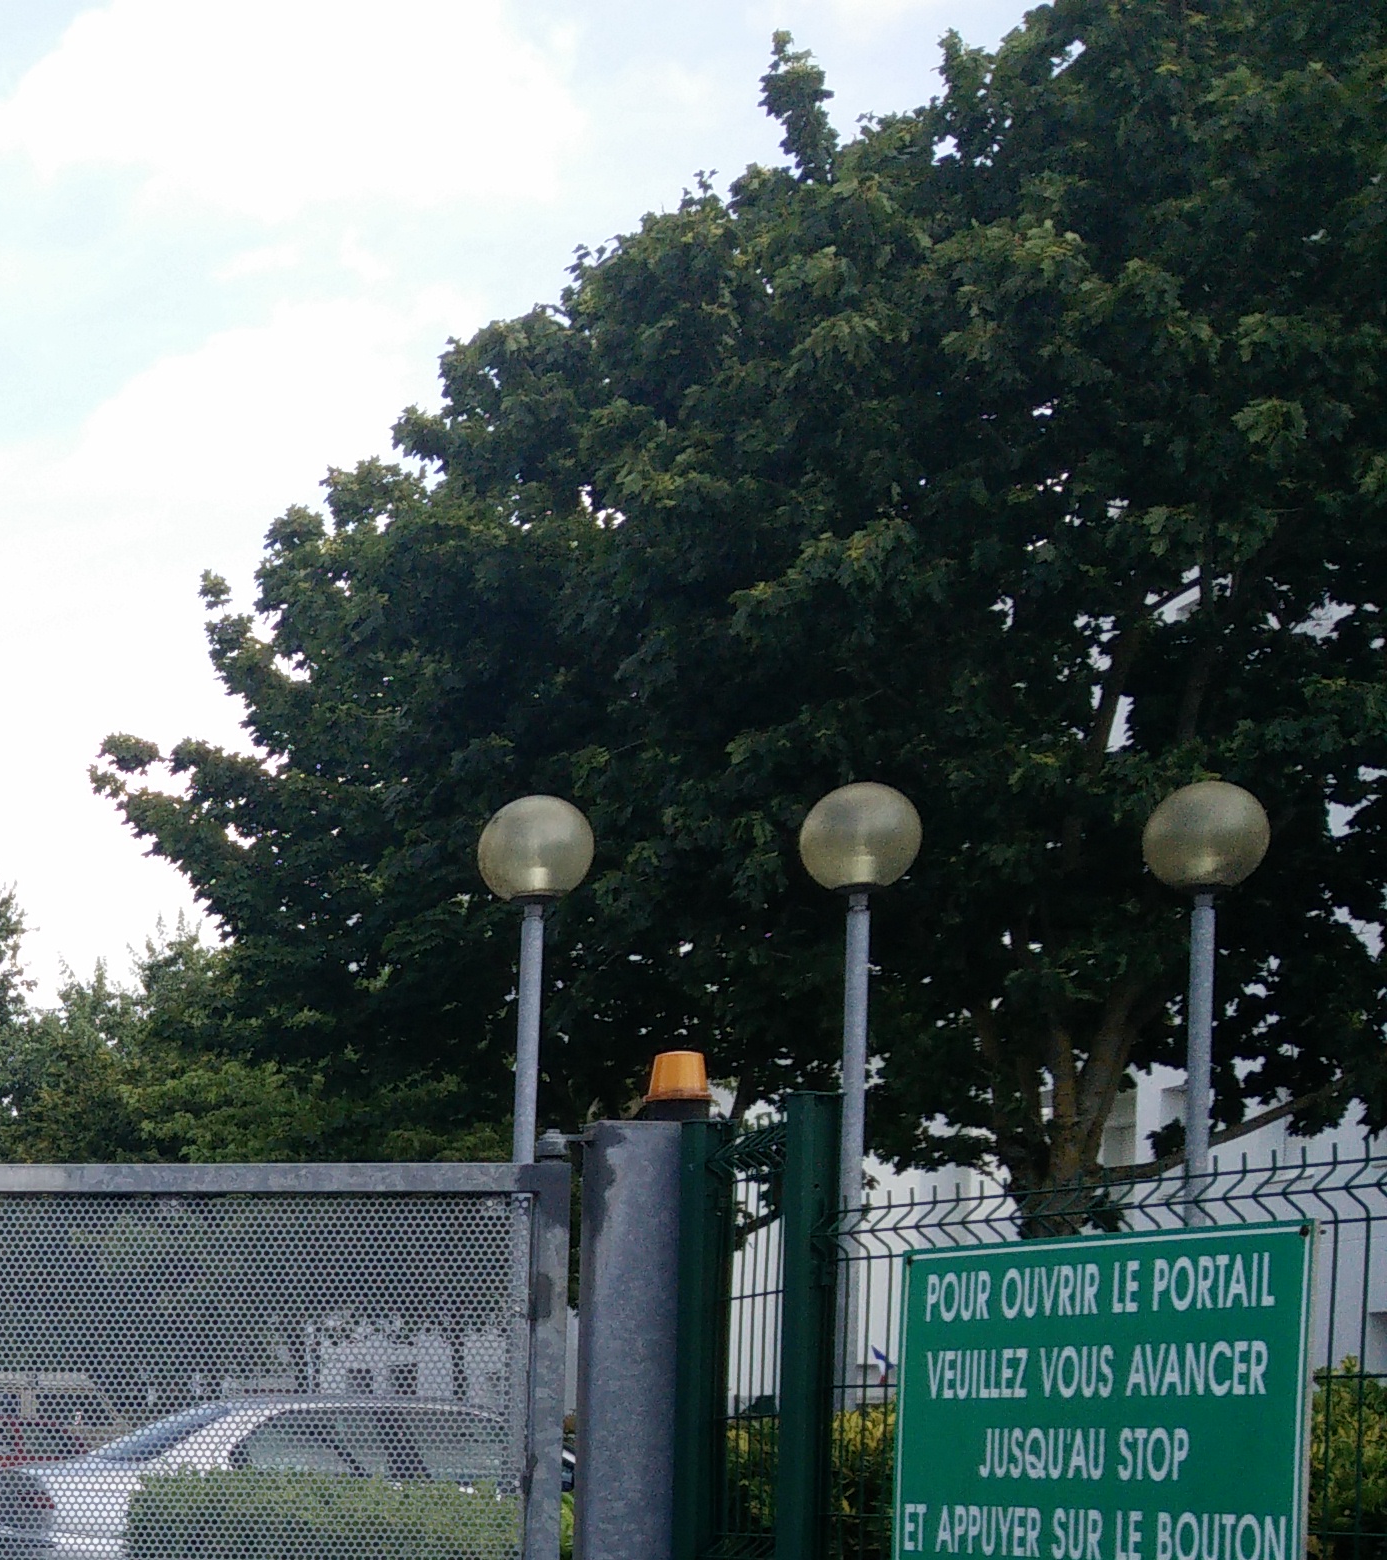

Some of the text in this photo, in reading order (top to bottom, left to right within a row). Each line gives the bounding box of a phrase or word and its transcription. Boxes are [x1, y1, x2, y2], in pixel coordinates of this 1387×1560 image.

[926, 1253, 1274, 1321] POUR OUVRIR LE PORTAIL
[928, 1341, 1267, 1399] VEUILLEZ VOUS AVANCER
[980, 1428, 1188, 1481] JUSQU'AU STOP
[905, 1504, 926, 1550] ET
[936, 1506, 1040, 1556] APPUYER
[1052, 1509, 1102, 1559] SUR
